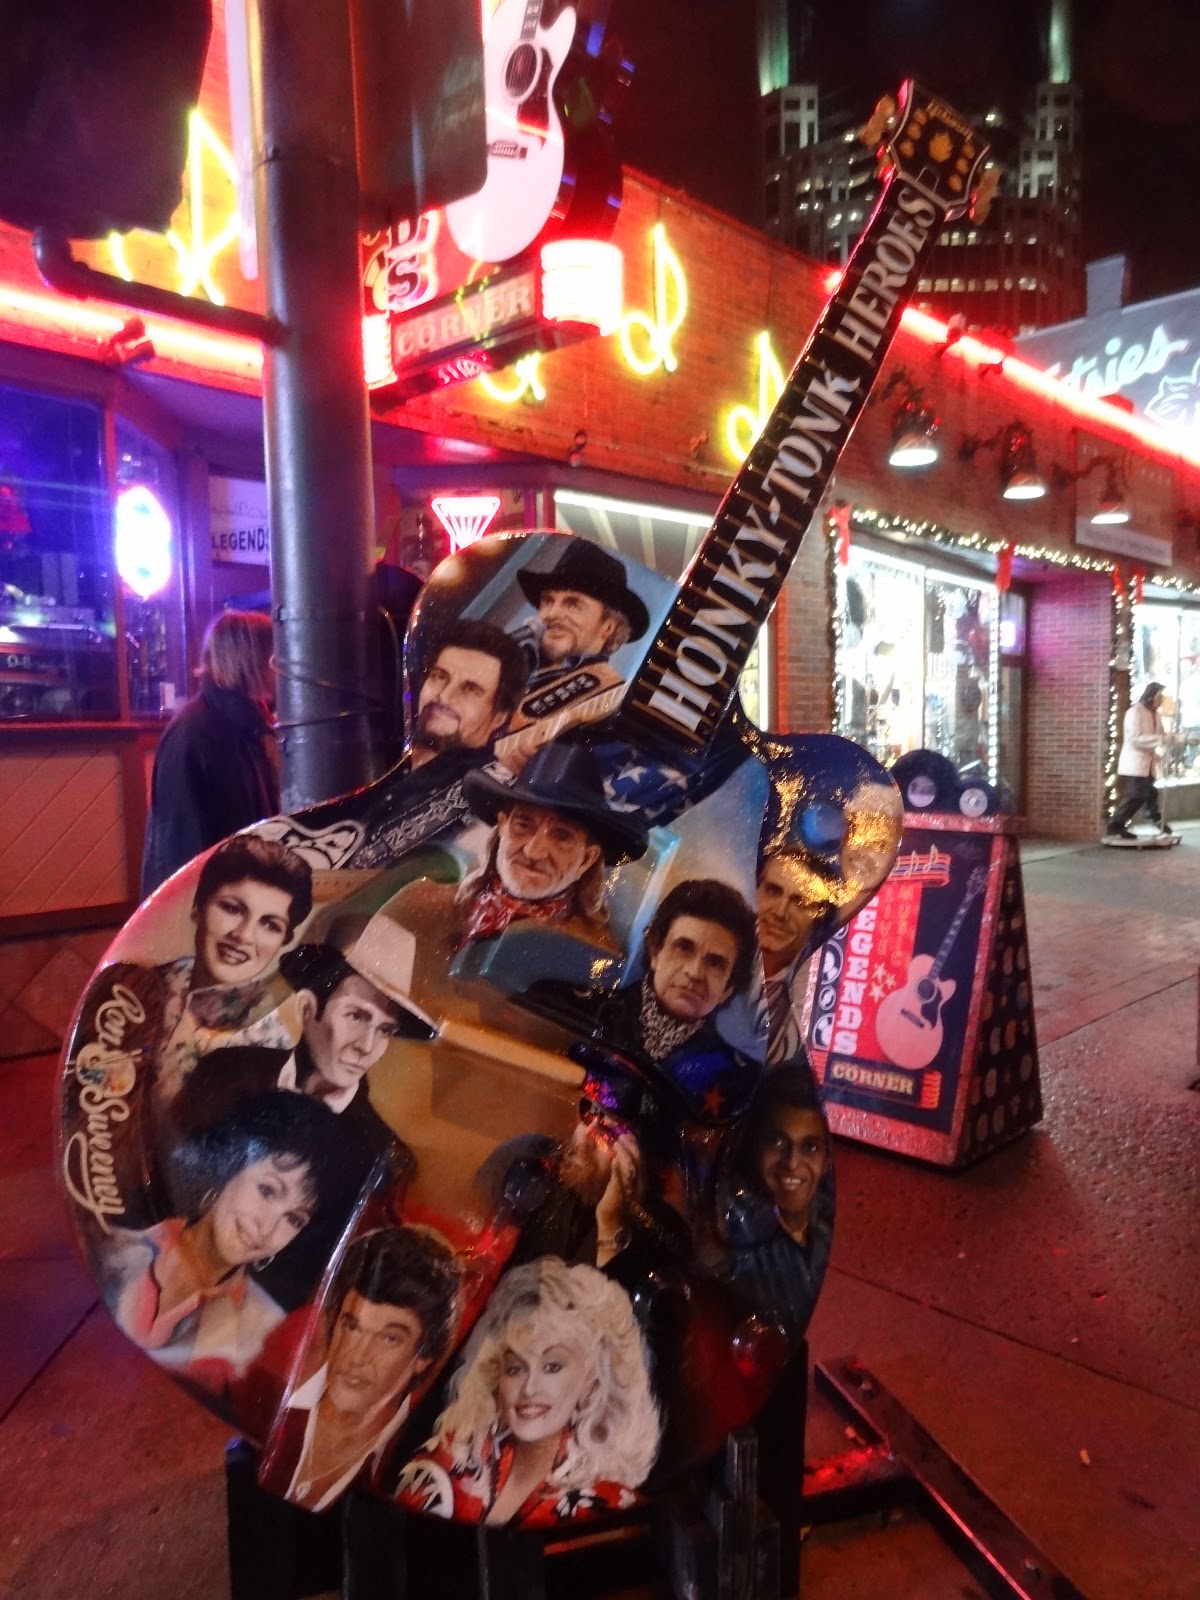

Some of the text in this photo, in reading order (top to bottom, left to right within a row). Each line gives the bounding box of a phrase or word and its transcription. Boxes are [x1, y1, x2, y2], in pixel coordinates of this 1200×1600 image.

[395, 285, 532, 358] CORNER
[1043, 324, 1189, 401] tries
[649, 187, 936, 732] HONKY-TONK HEROES
[878, 886, 895, 956] LIVE
[890, 885, 914, 967] MUSIC
[831, 1060, 915, 1096] CORNER
[63, 1085, 131, 1236] Sweeney
